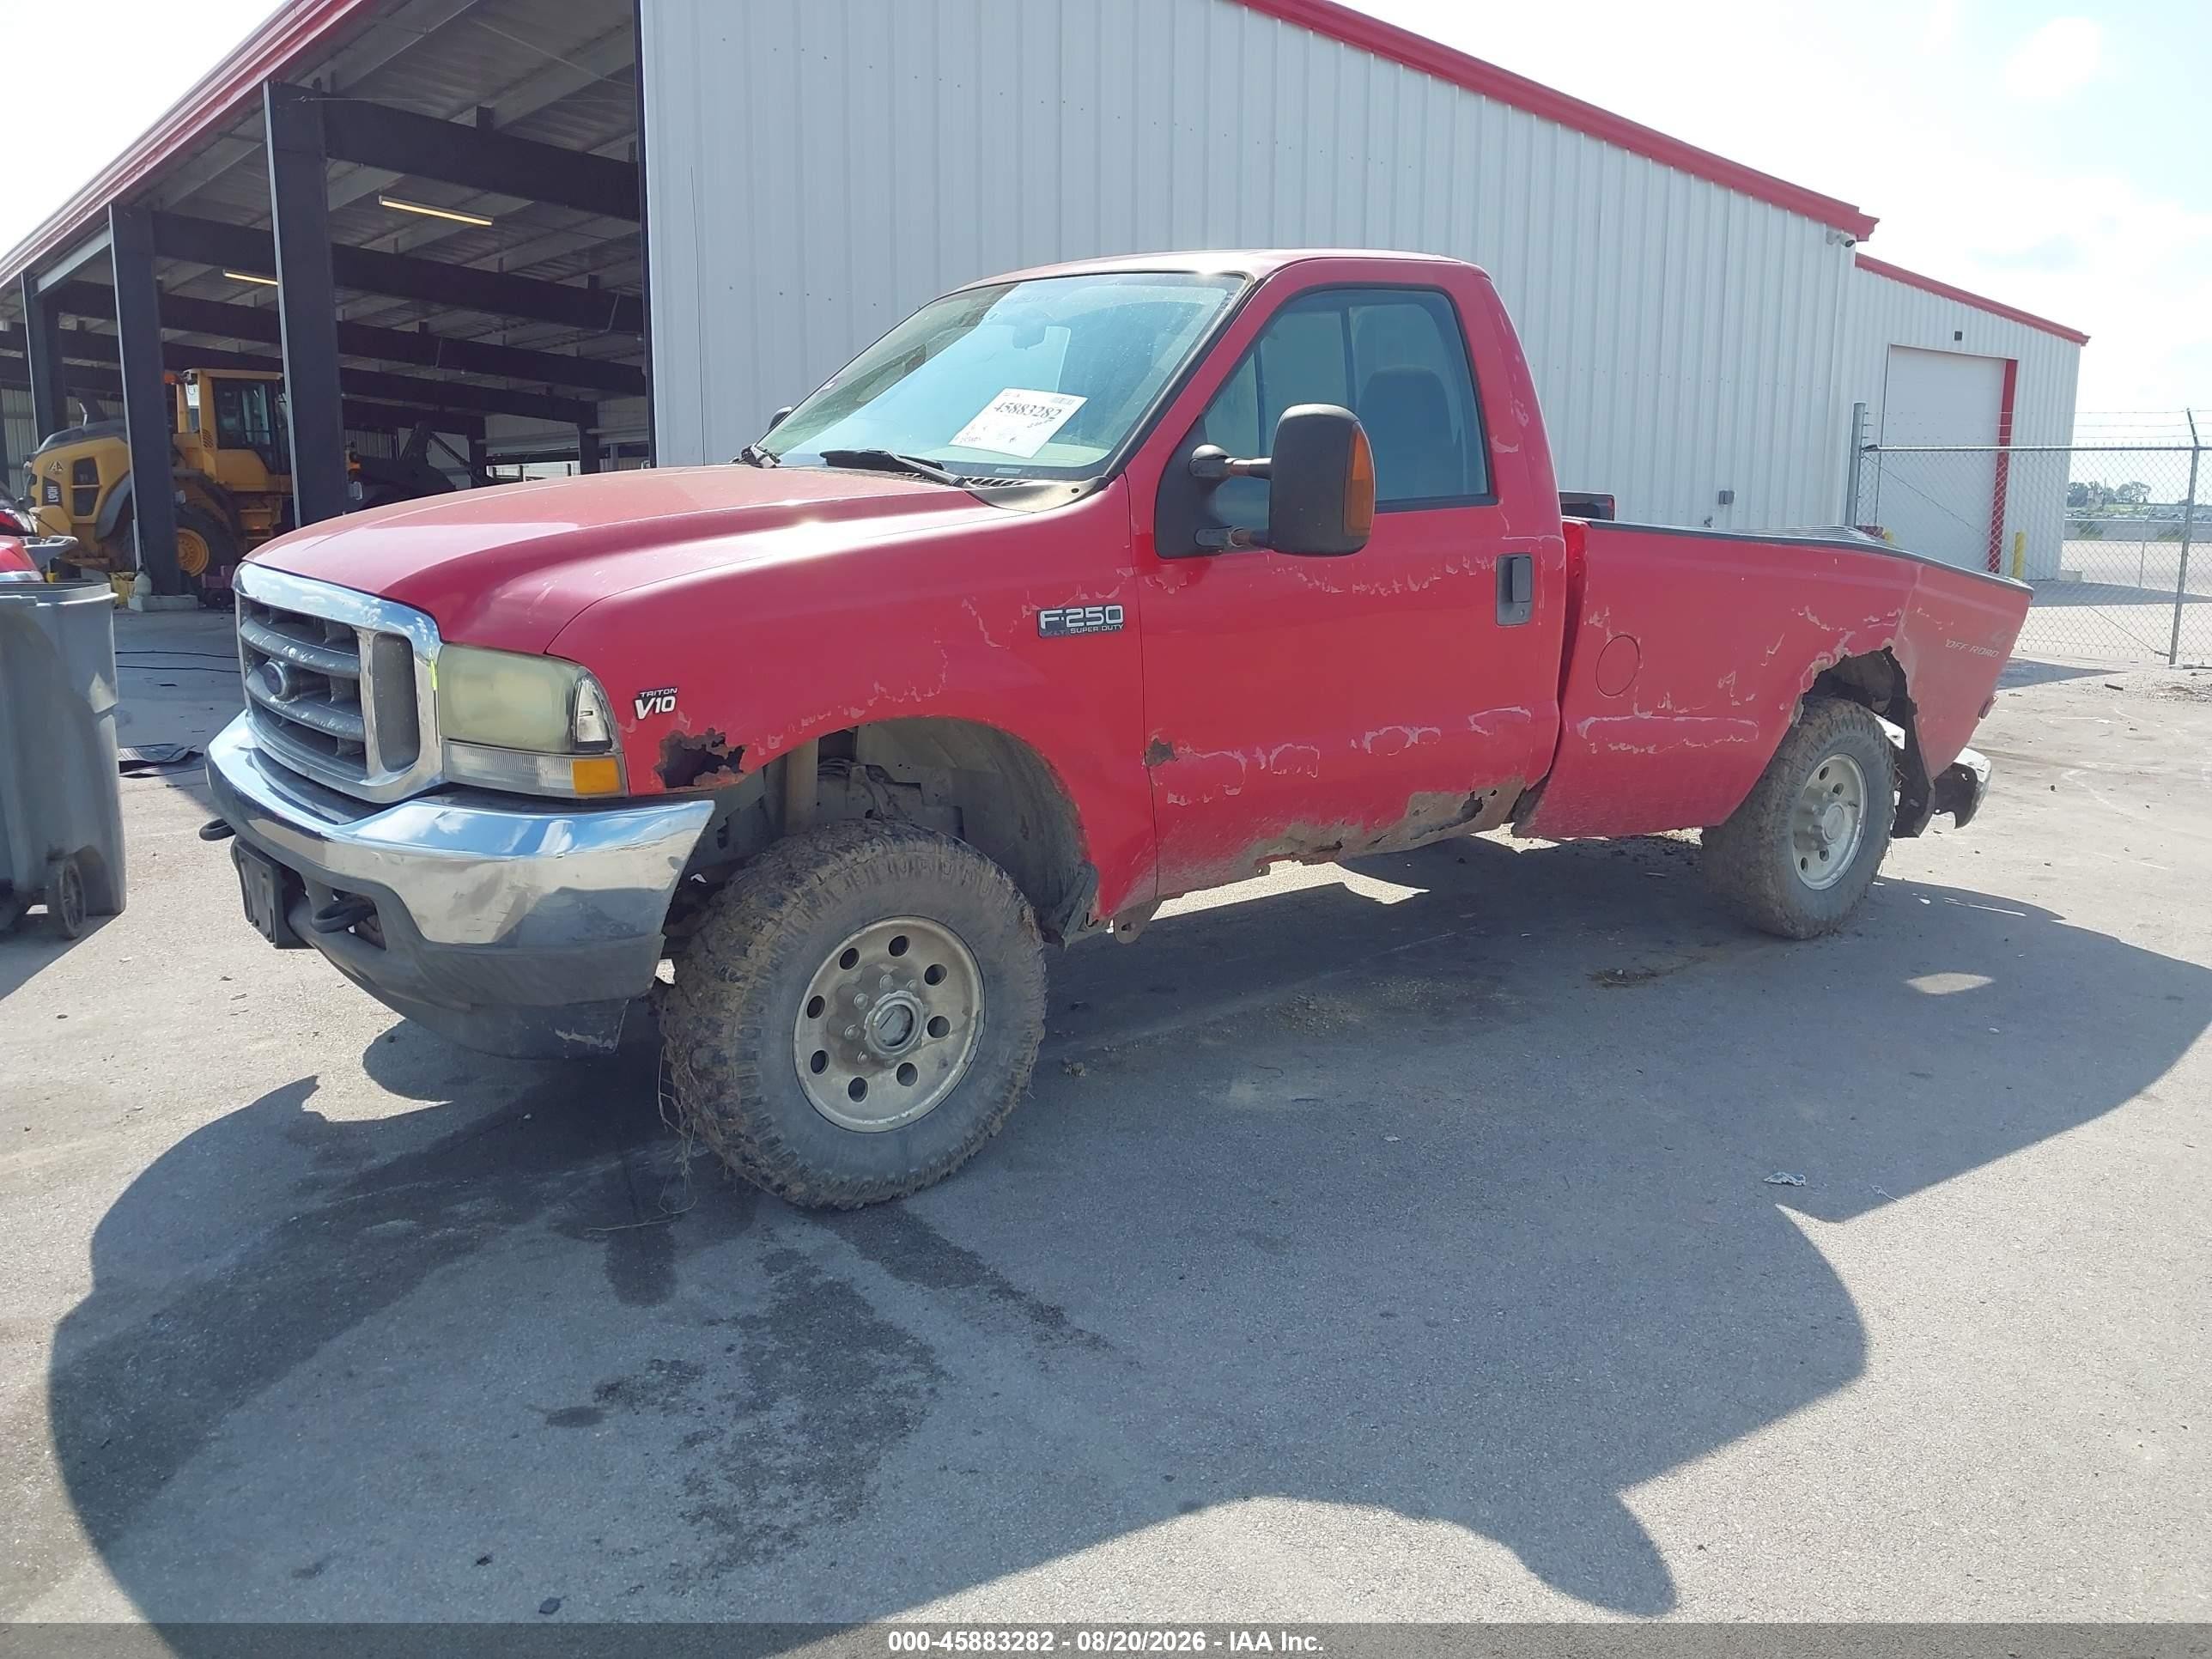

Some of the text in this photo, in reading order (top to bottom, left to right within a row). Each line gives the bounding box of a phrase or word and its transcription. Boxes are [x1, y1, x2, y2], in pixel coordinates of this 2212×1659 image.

[994, 402, 1062, 420] 45883282
[1101, 623, 1124, 632] DUTY
[1946, 640, 2000, 658] OFF ROAD
[639, 687, 678, 697] TRITON
[635, 696, 676, 720] V10
